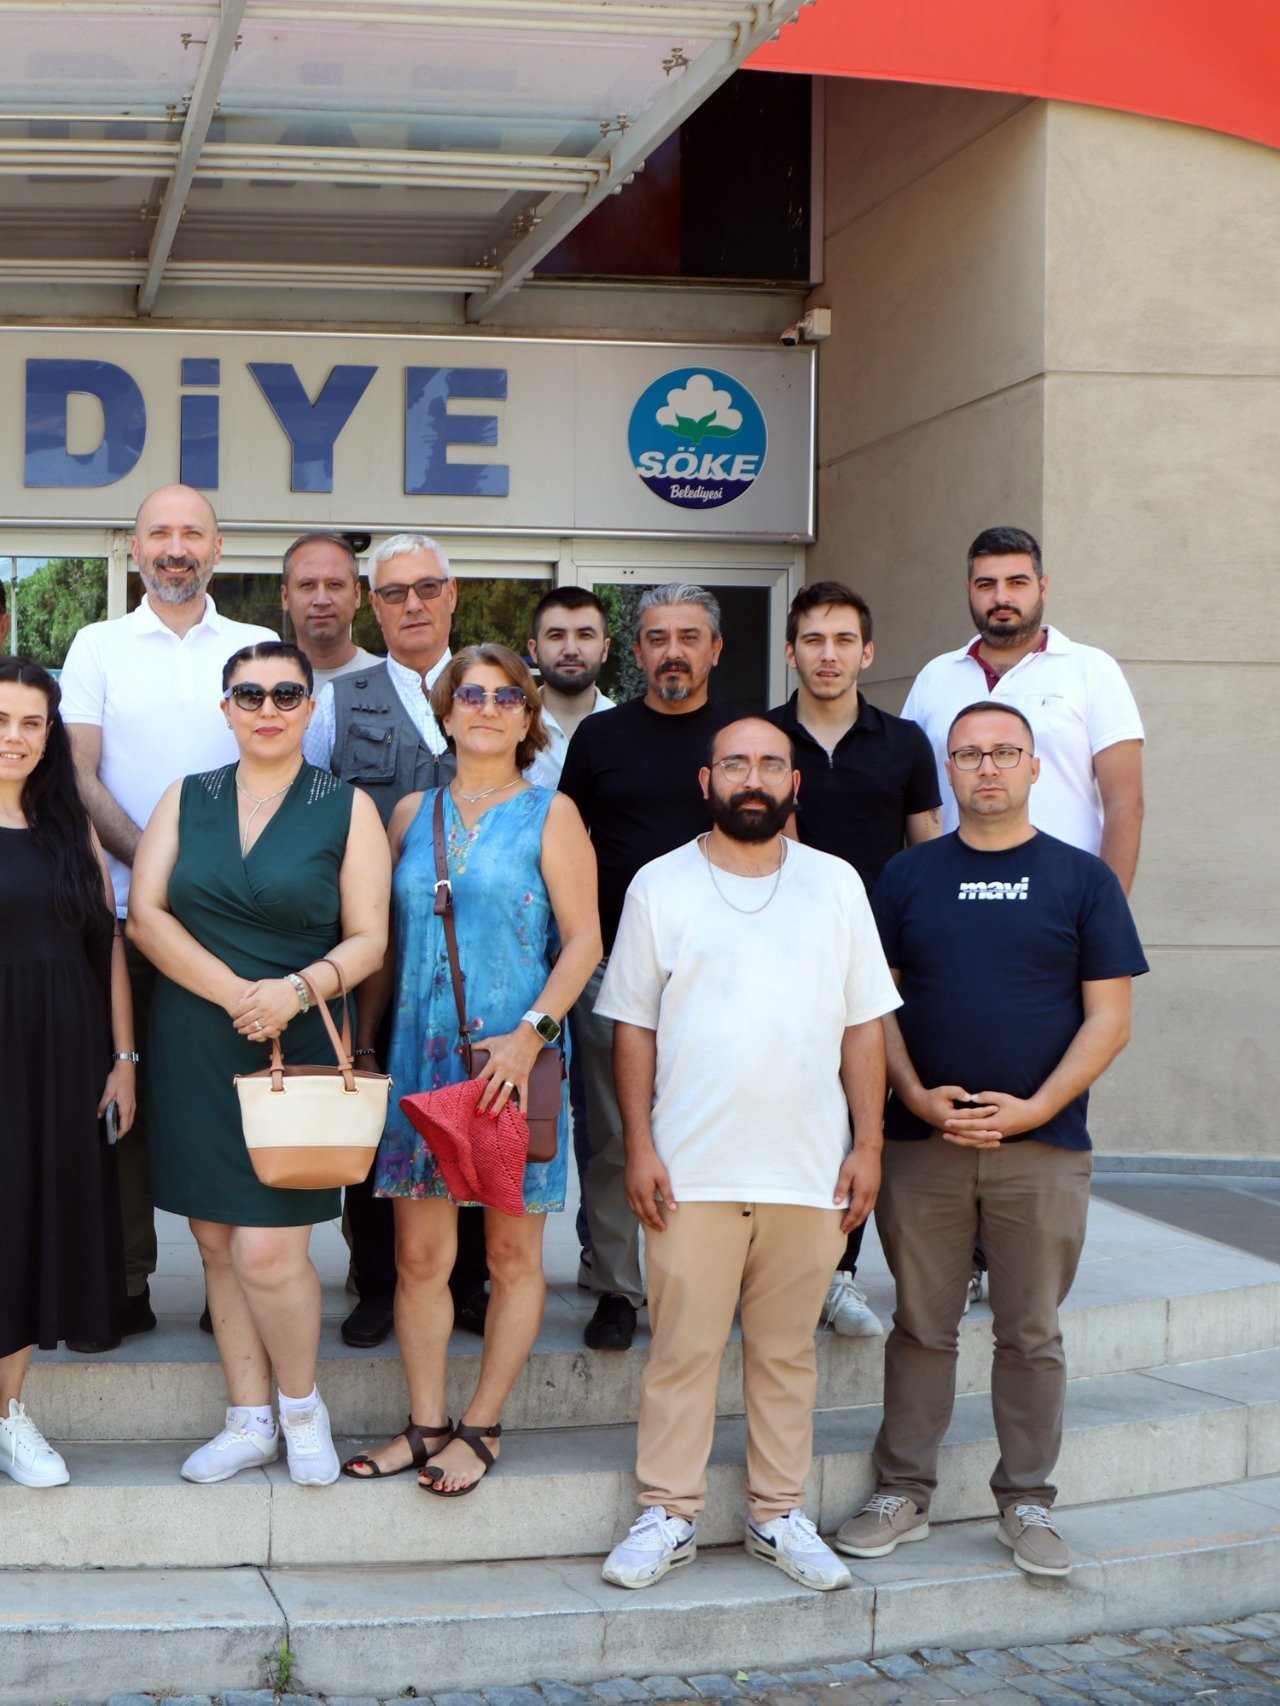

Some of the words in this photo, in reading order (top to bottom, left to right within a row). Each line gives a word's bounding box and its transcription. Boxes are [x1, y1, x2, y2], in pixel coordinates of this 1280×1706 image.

[637, 446, 759, 480] SÖKE
[670, 484, 723, 502] Belediyesi
[958, 877, 1029, 900] mavi
